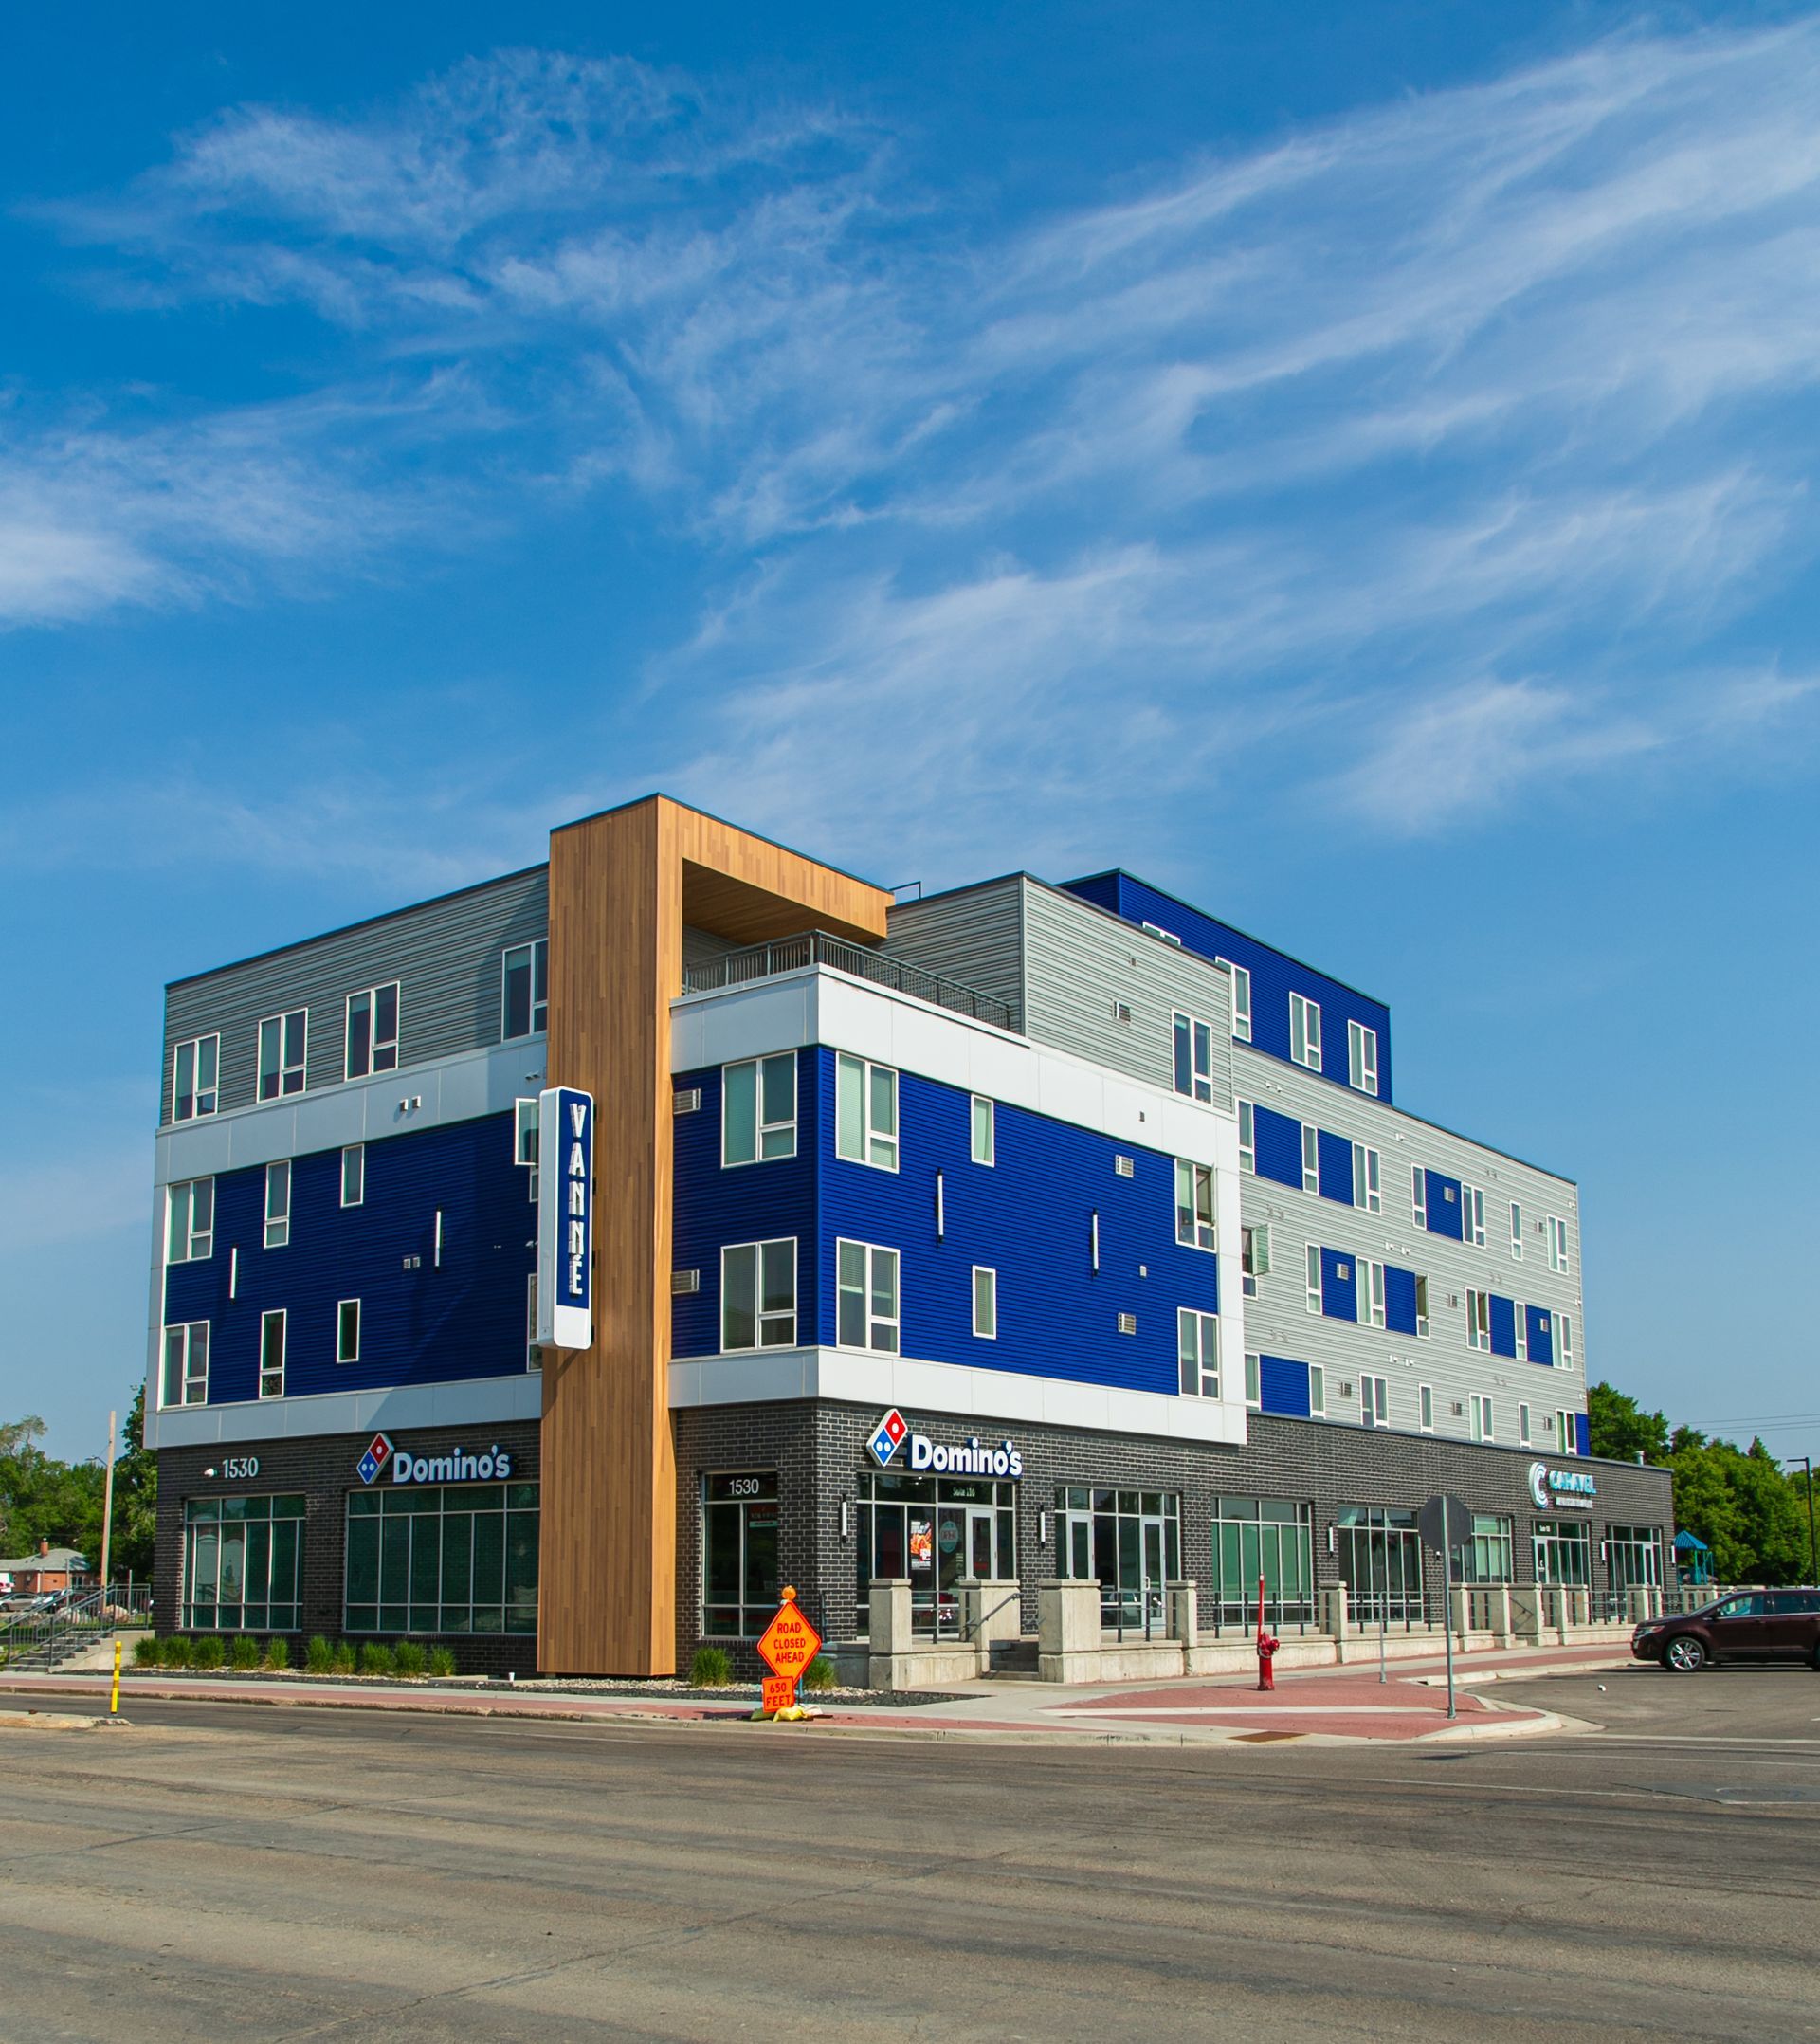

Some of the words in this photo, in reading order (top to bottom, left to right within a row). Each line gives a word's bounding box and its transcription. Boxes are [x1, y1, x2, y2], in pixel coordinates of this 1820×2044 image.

[569, 1103, 587, 1295] VANNÉ
[911, 1434, 1023, 1476] Domino's
[222, 1457, 259, 1479] 1530
[392, 1443, 511, 1483] Domino's
[729, 1478, 760, 1495] 1530
[776, 1622, 802, 1634] ROAD
[774, 1638, 806, 1650] CLOSED
[775, 1651, 804, 1664] AHEAD
[769, 1682, 787, 1693] 650
[766, 1695, 791, 1706] FEET
